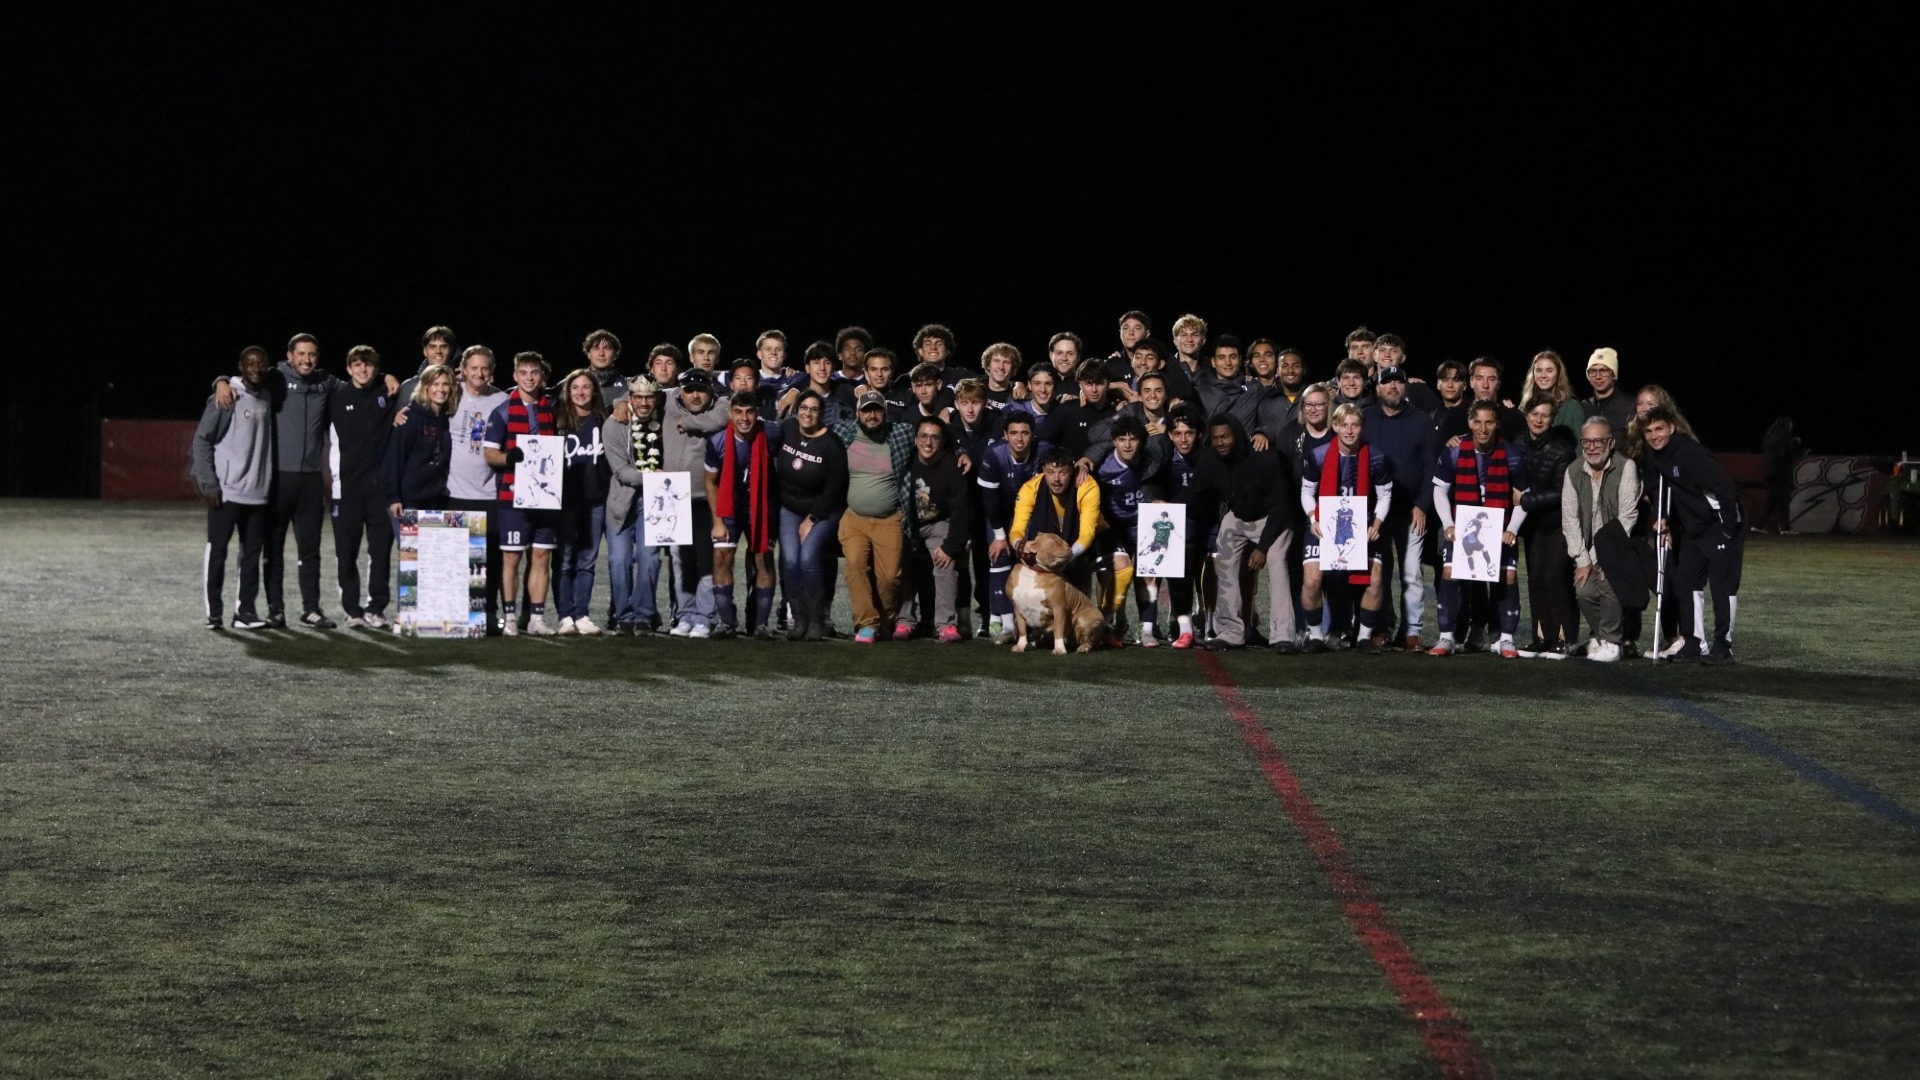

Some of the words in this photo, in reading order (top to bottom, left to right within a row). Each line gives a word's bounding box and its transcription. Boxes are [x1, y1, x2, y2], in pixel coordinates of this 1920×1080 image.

[565, 426, 604, 466] Pack
[782, 444, 795, 455] CSU
[795, 450, 823, 464] PUEBLO
[507, 530, 520, 544] 18
[1304, 545, 1320, 558] 30
[1443, 548, 1448, 562] 2
